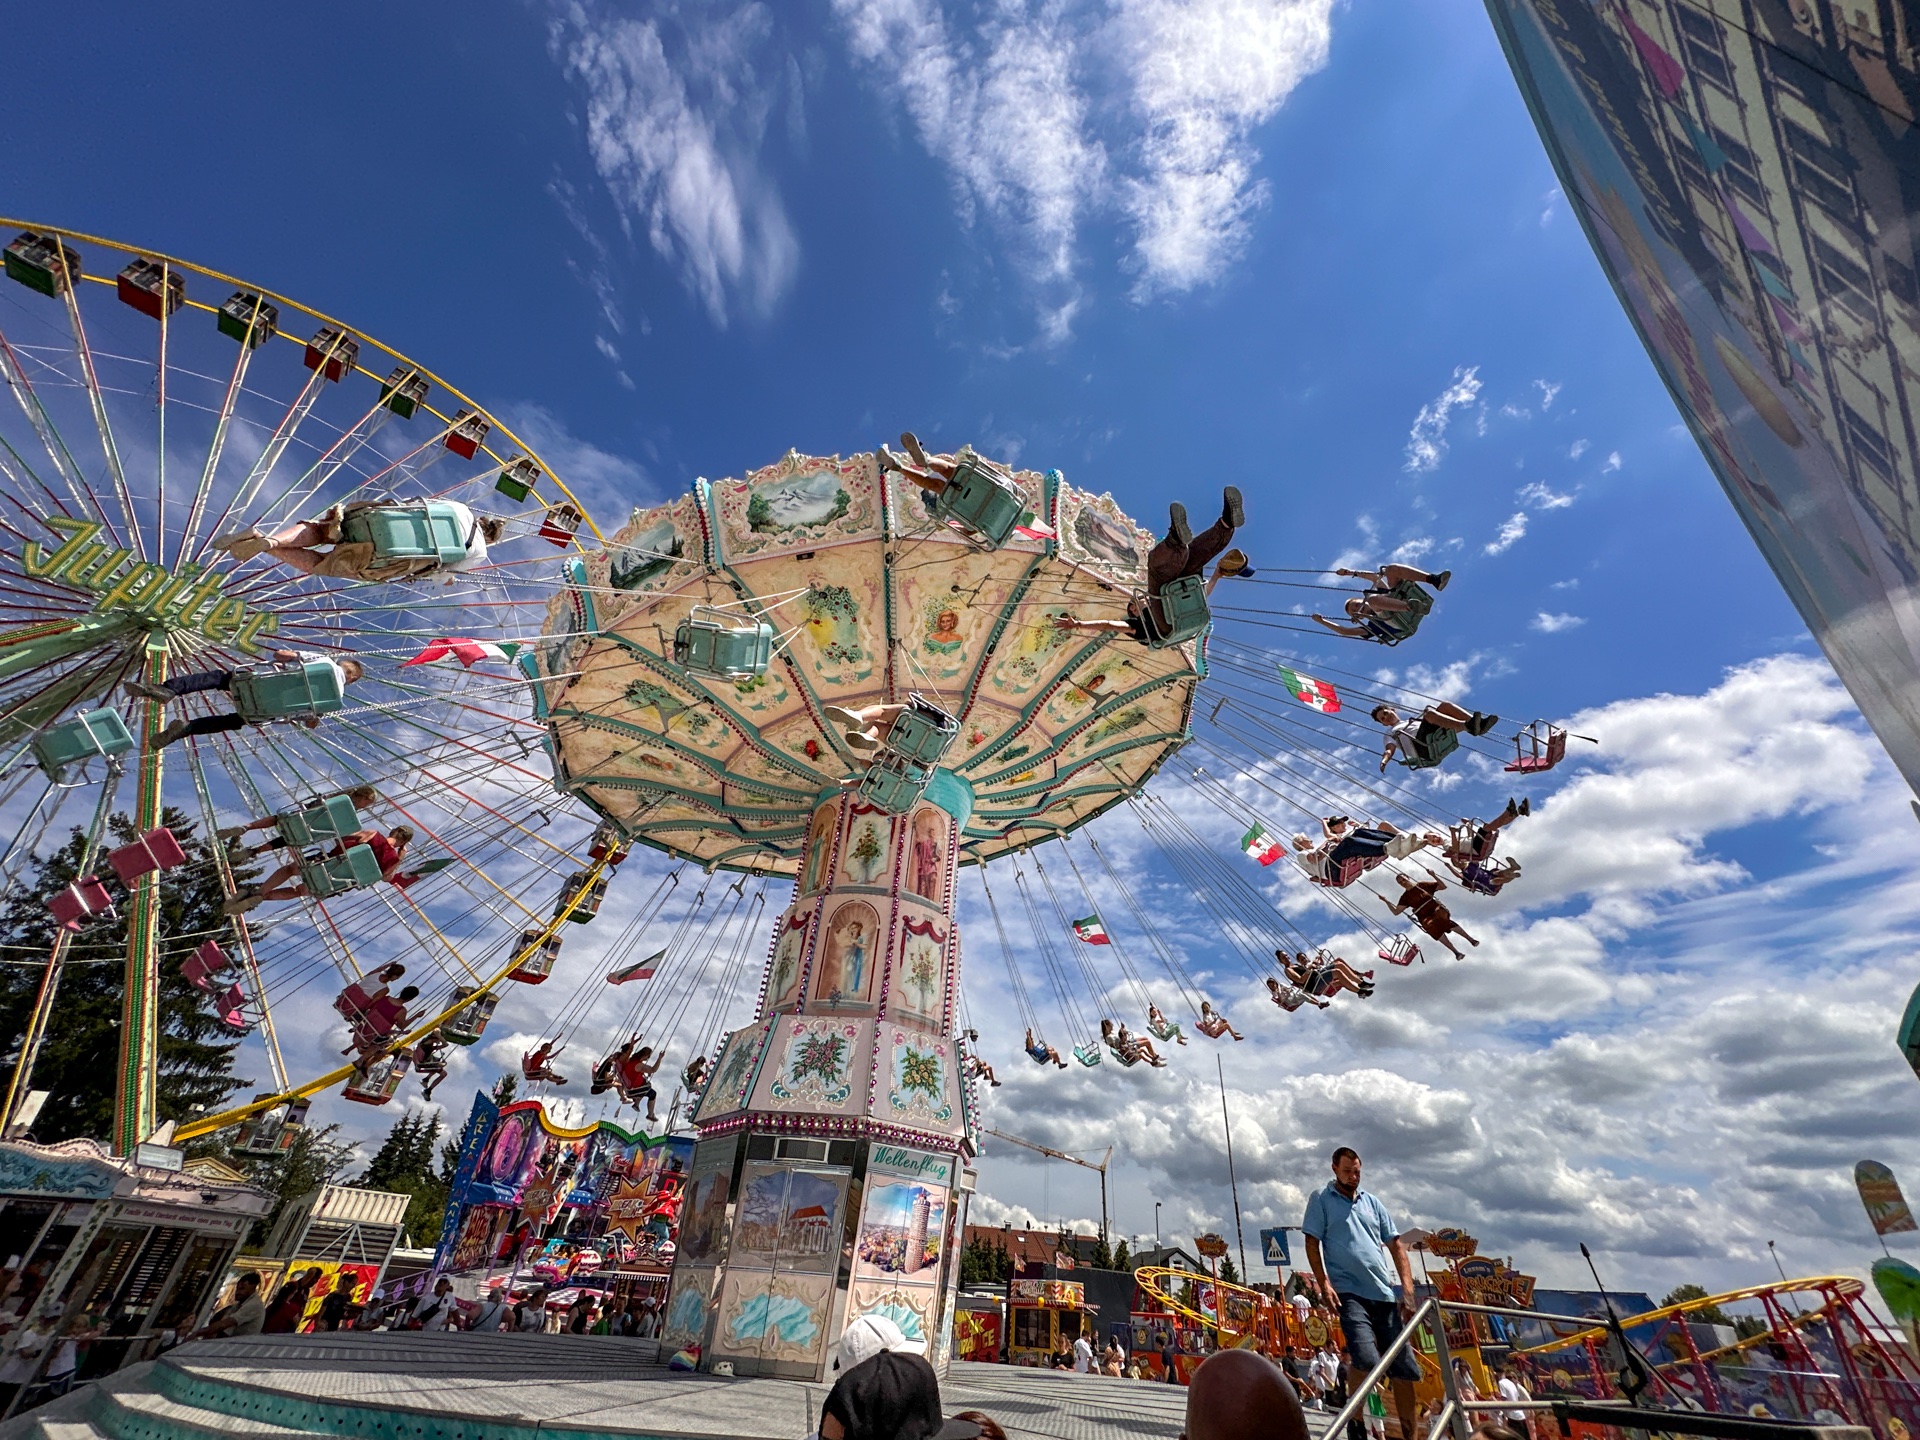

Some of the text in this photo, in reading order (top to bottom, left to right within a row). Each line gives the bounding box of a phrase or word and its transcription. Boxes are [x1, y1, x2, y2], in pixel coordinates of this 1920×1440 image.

[23, 514, 280, 654] Jupiter
[873, 1146, 947, 1180] Wellenflug
[954, 1317, 986, 1340] REAK
